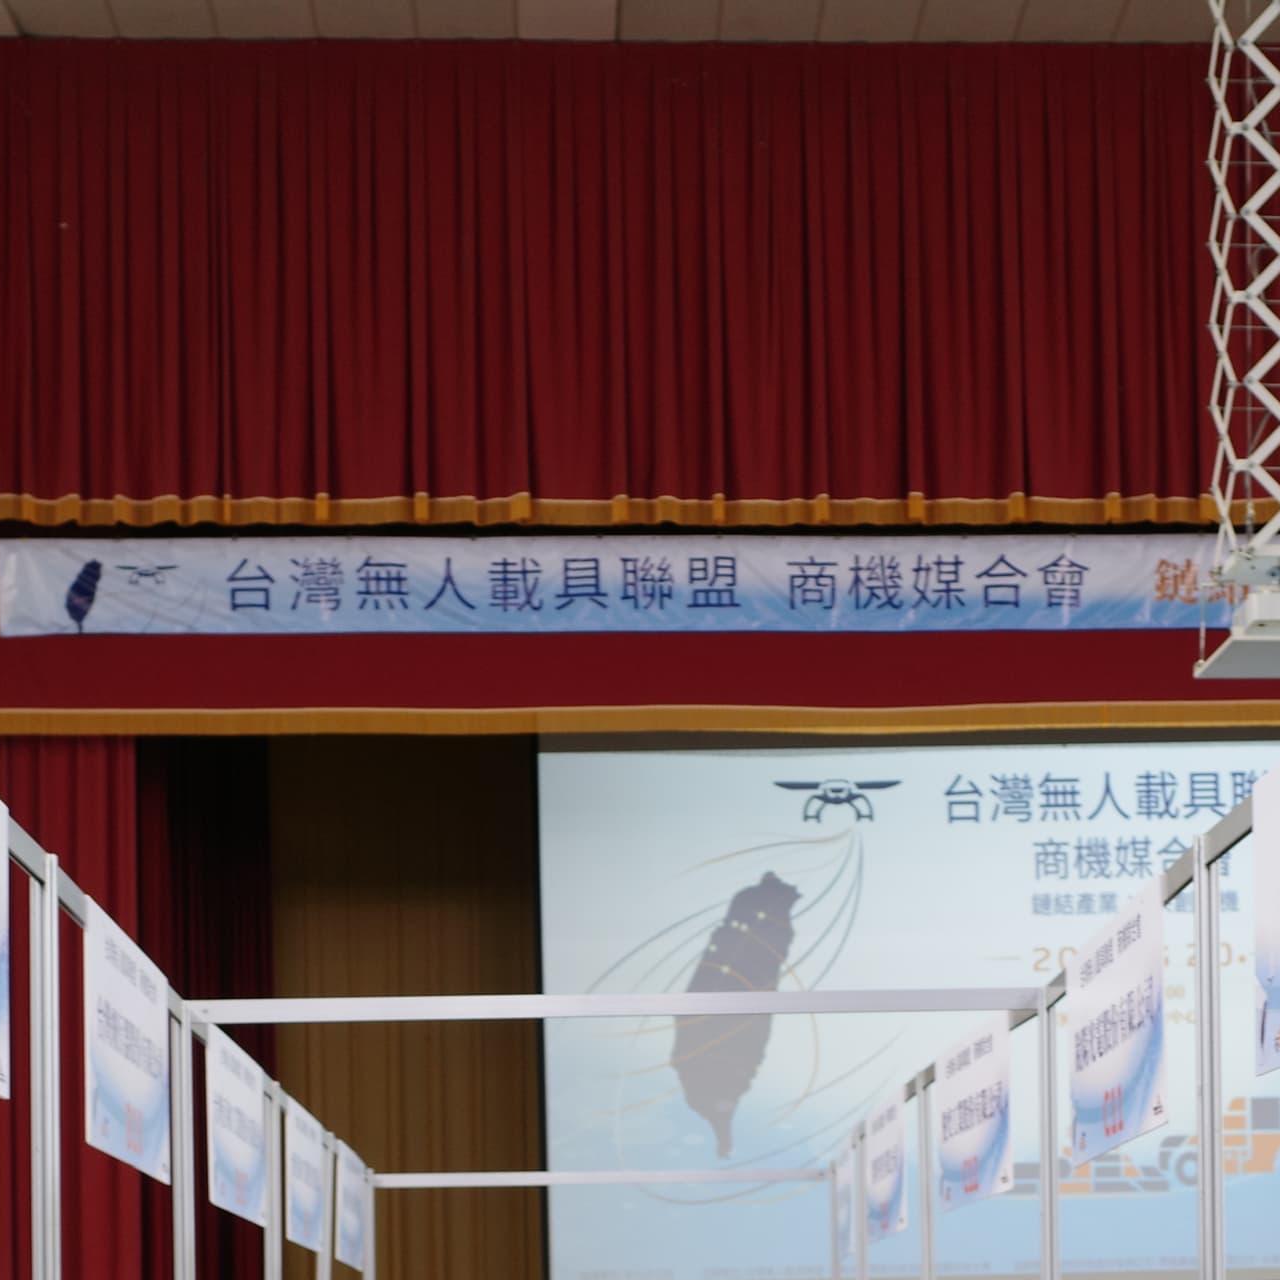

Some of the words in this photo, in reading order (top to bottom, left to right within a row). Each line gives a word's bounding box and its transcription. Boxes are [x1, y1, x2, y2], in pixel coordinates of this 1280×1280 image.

[224, 554, 742, 614] 台灣無人載具聯盟
[786, 552, 1093, 611] 商機媒合會
